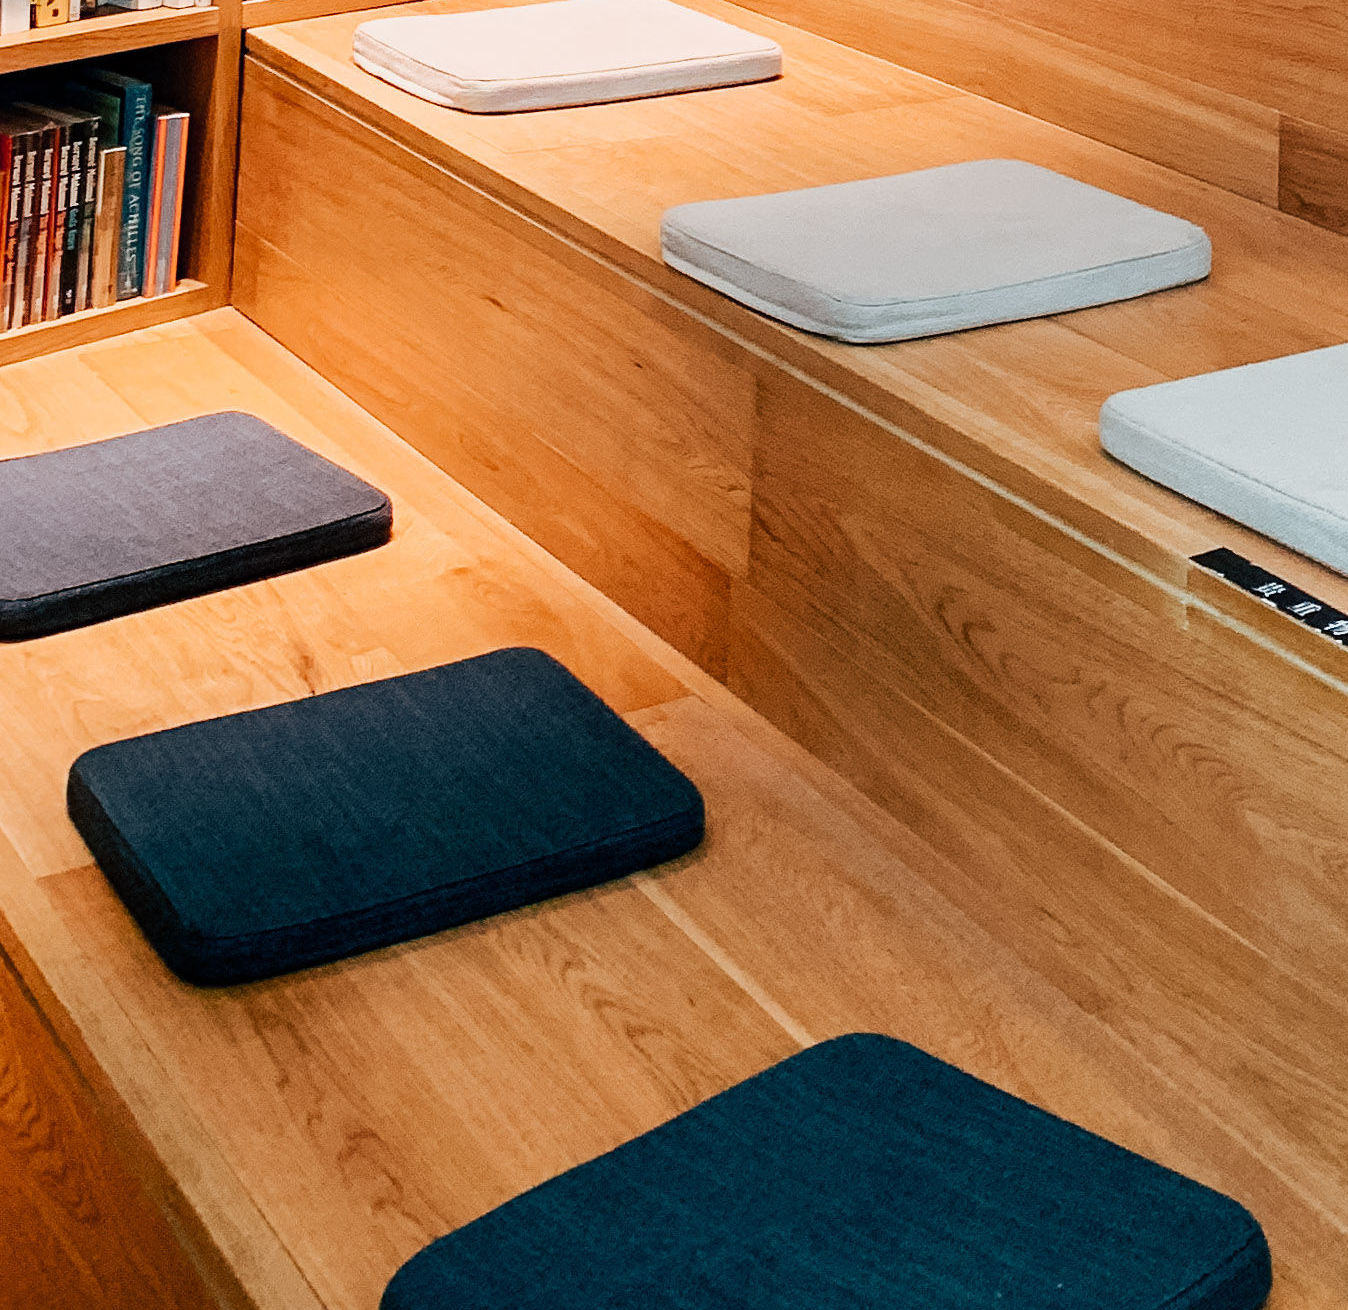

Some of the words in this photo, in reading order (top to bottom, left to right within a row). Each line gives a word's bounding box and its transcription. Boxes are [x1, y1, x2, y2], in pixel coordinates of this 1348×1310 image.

[135, 94, 147, 117] THE
[132, 122, 145, 166] SONG
[129, 170, 141, 190] OF
[125, 193, 140, 263] ACHILLES
